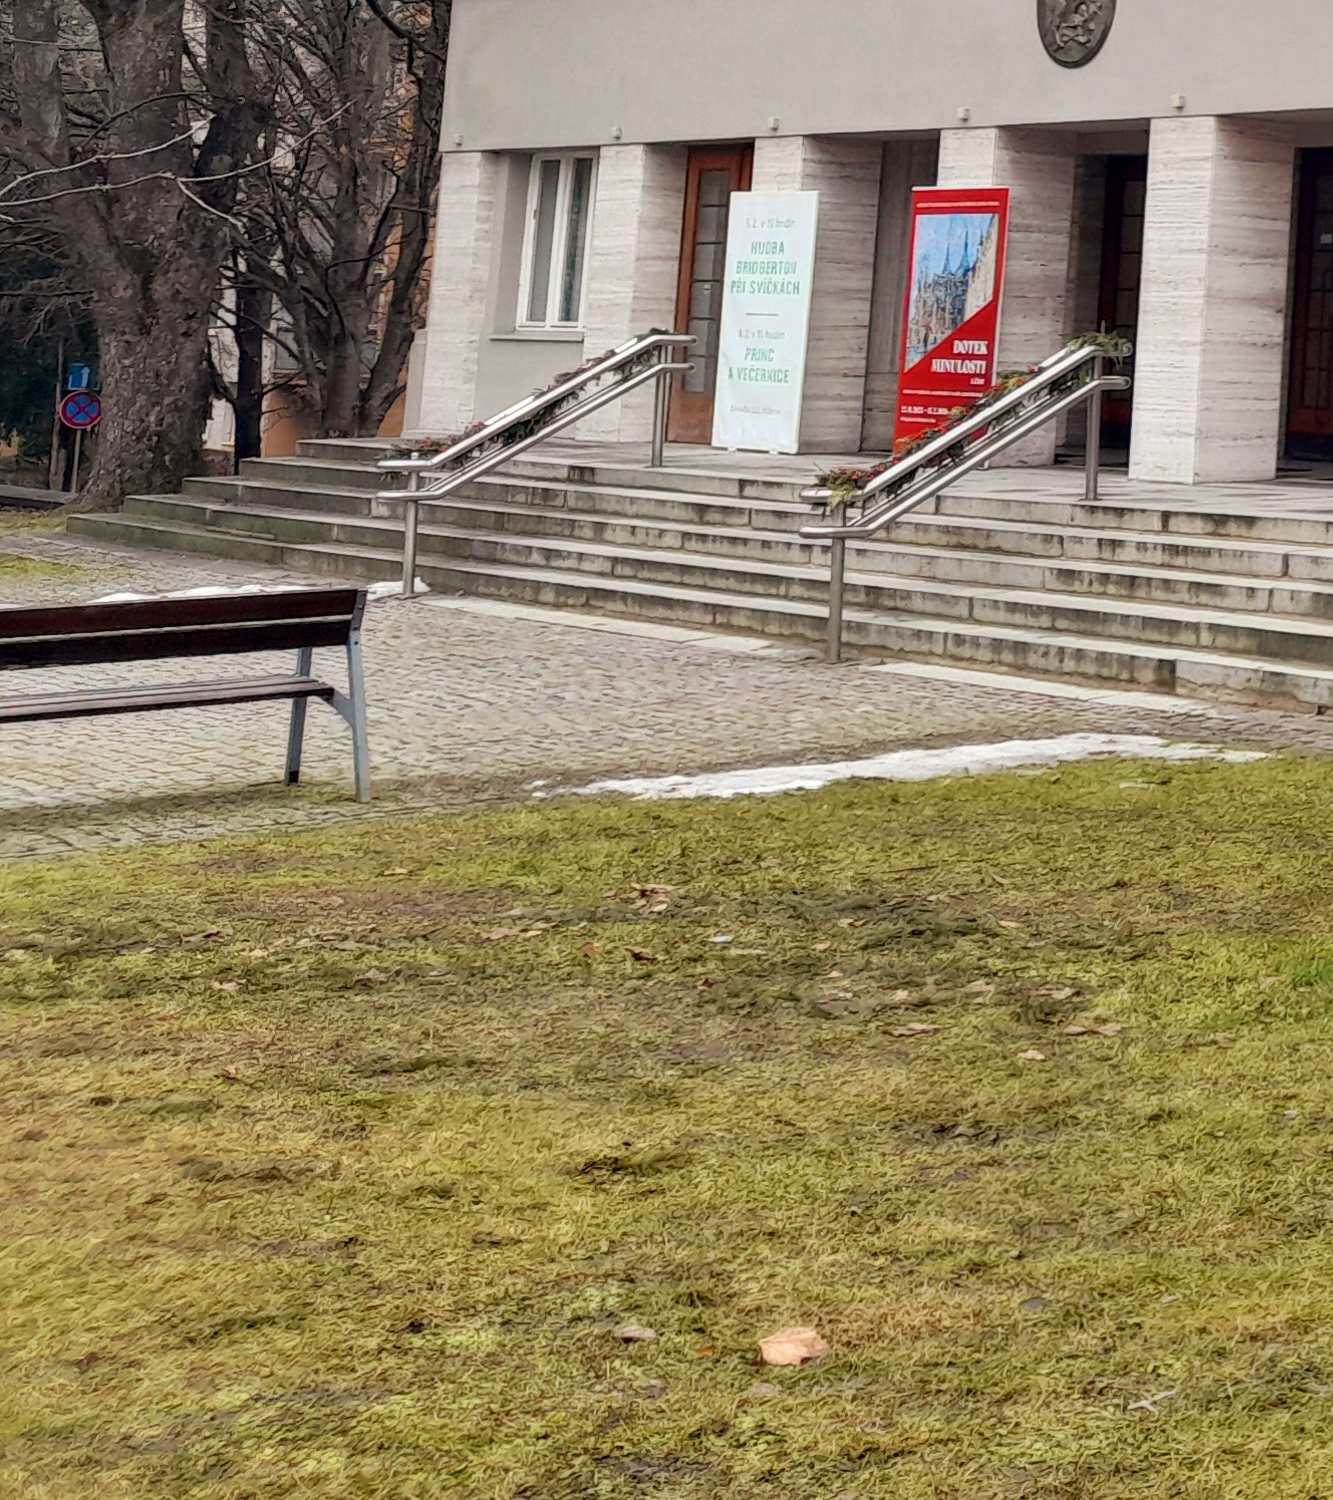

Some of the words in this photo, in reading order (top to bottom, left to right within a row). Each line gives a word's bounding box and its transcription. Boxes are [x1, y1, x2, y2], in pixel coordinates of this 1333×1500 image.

[751, 241, 785, 256] HUDBA
[736, 261, 798, 275] BRIDGERTON
[749, 277, 801, 296] SVÍČKÁCH
[744, 347, 775, 362] PRINC
[953, 340, 988, 355] DOTEK
[728, 366, 734, 381] A
[736, 364, 791, 384] VEČERNICE
[930, 358, 987, 375] MINULOSTI
